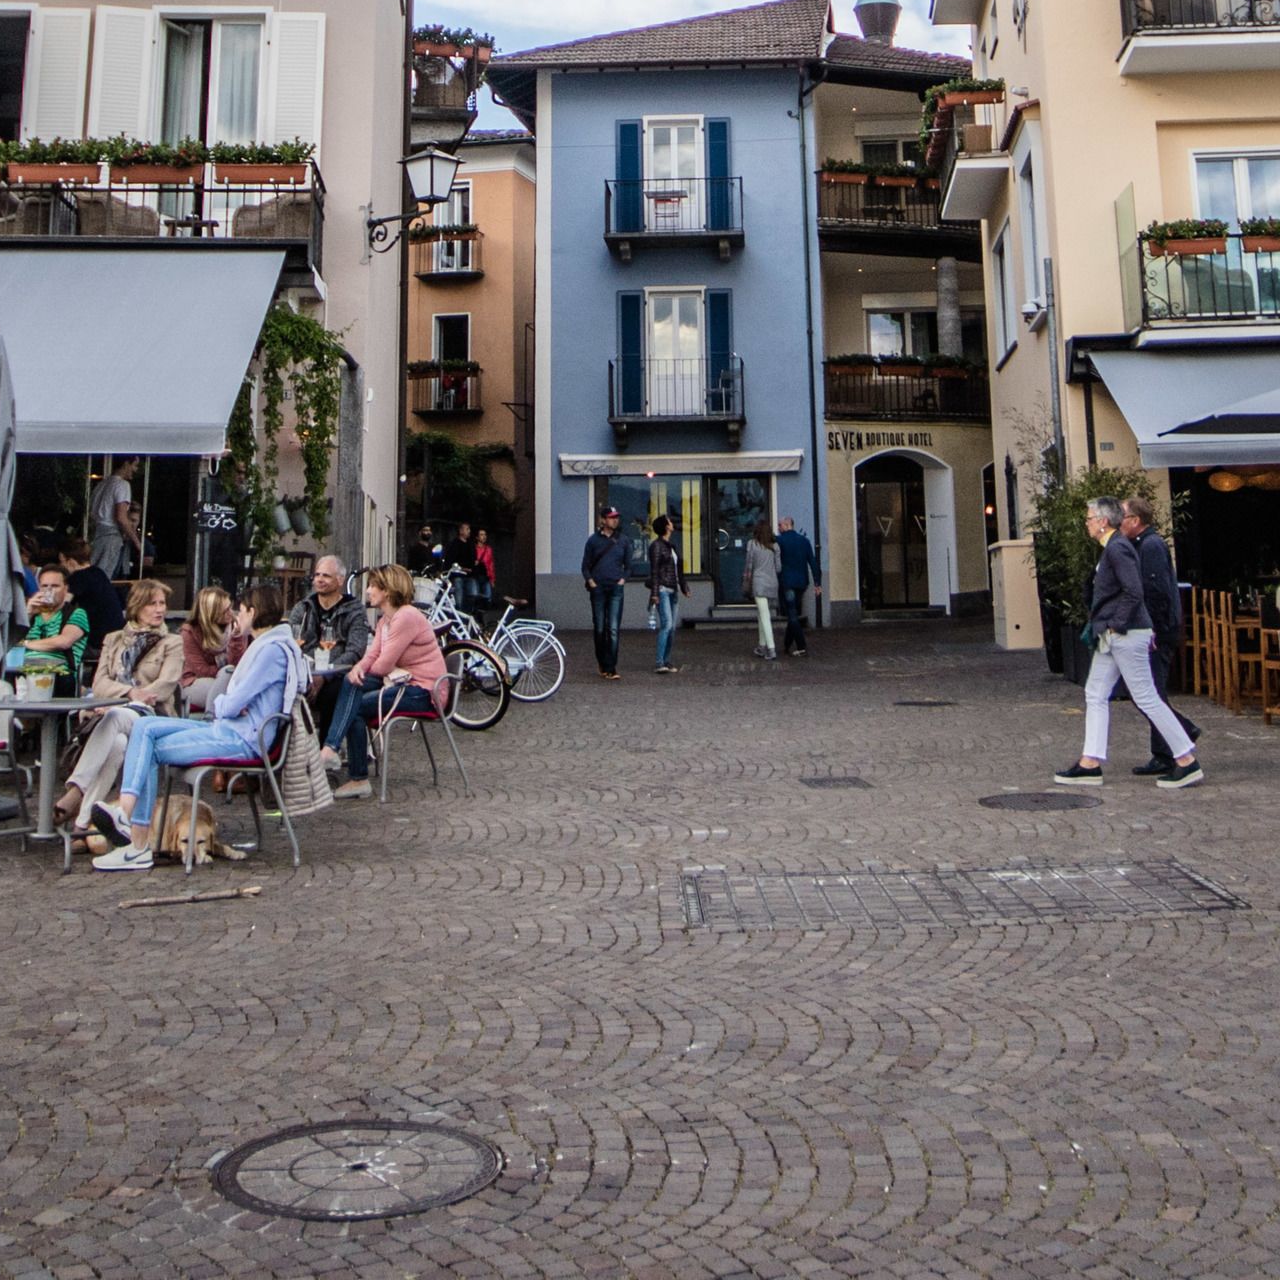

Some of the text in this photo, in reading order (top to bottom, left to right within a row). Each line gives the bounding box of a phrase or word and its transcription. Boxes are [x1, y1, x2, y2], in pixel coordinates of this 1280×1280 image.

[827, 431, 934, 451] SEVEN BOUTIQUE HOTEL
